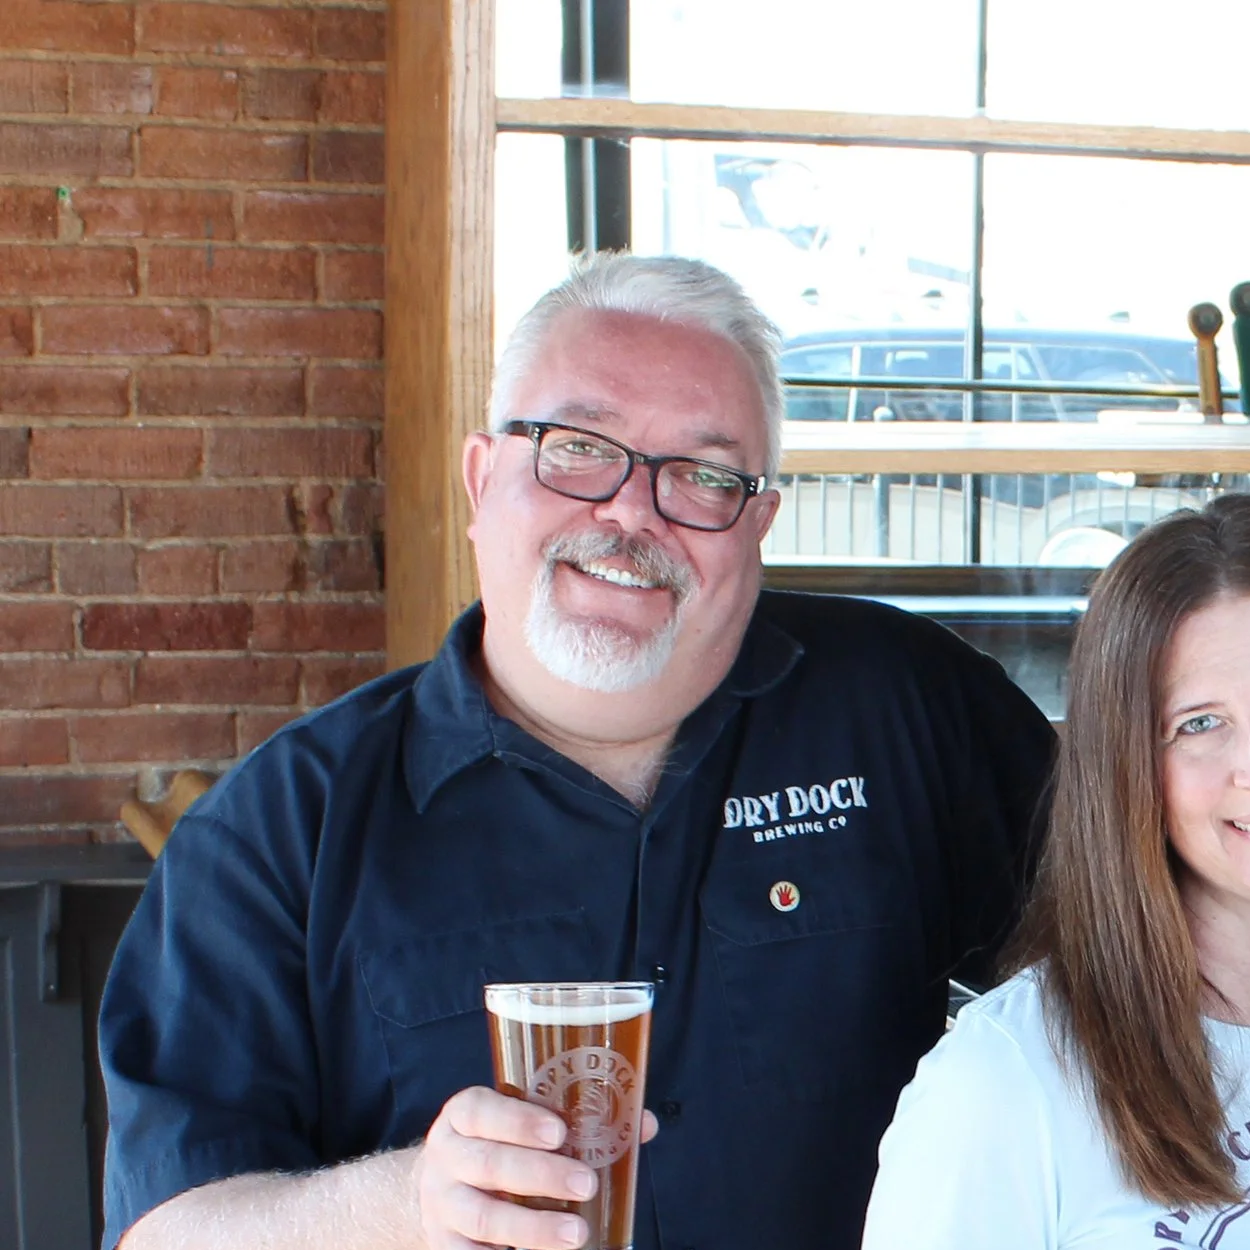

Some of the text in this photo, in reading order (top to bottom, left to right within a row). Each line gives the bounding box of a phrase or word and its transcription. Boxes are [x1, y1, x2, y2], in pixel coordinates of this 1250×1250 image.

[723, 776, 868, 828] DRY DOCK
[753, 821, 824, 843] BREWING
